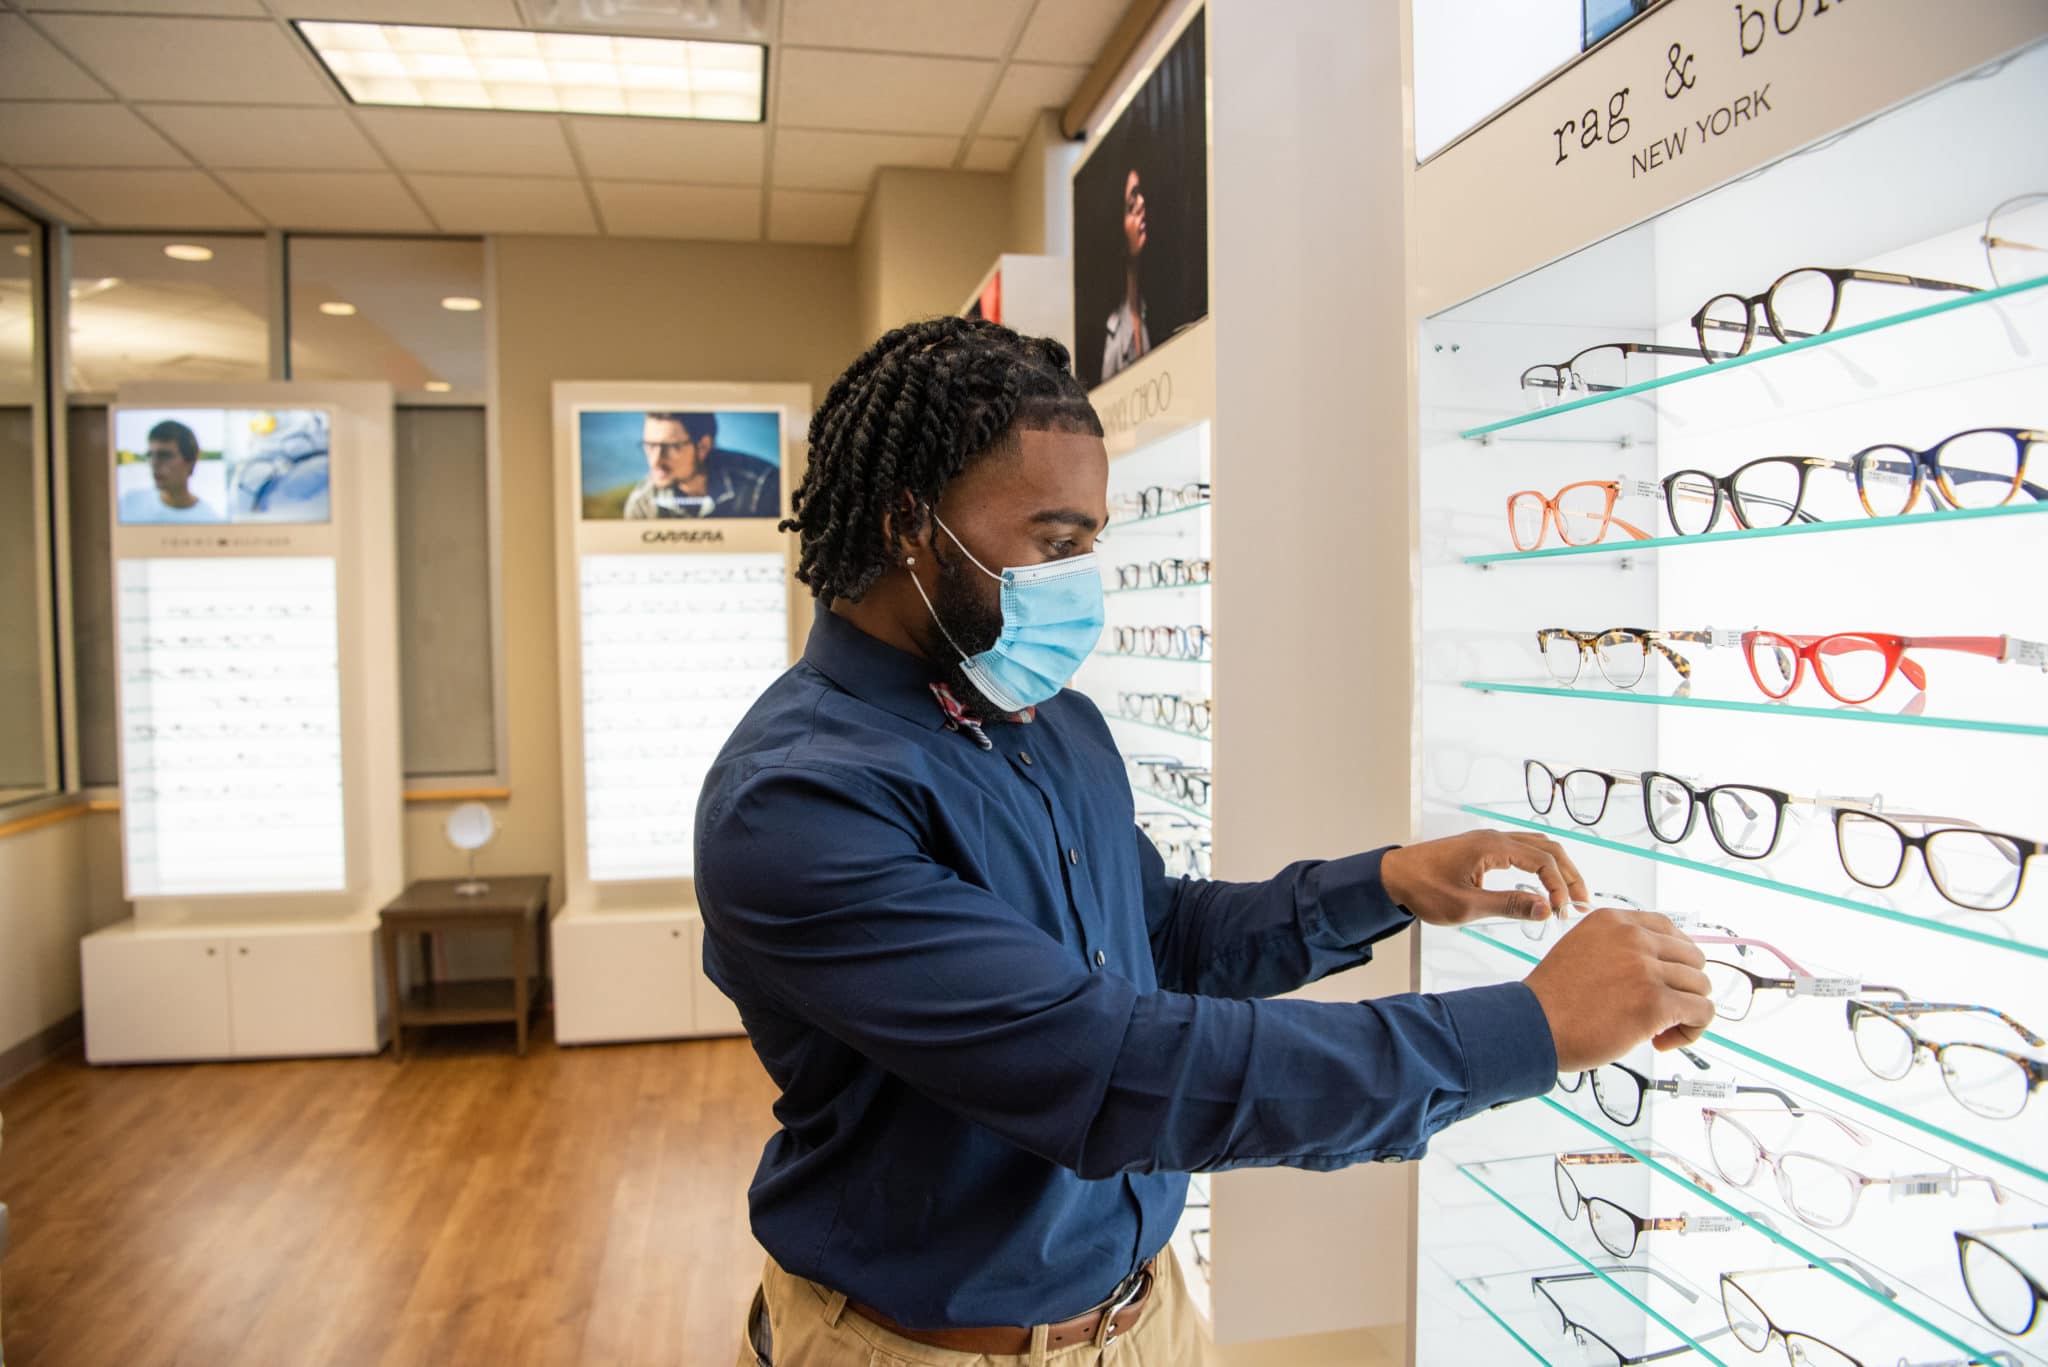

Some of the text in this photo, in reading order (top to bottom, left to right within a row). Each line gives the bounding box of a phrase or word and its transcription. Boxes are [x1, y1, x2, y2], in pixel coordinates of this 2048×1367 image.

[1553, 0, 1846, 166] rag & bo
[1631, 82, 1772, 179] NEW YORK
